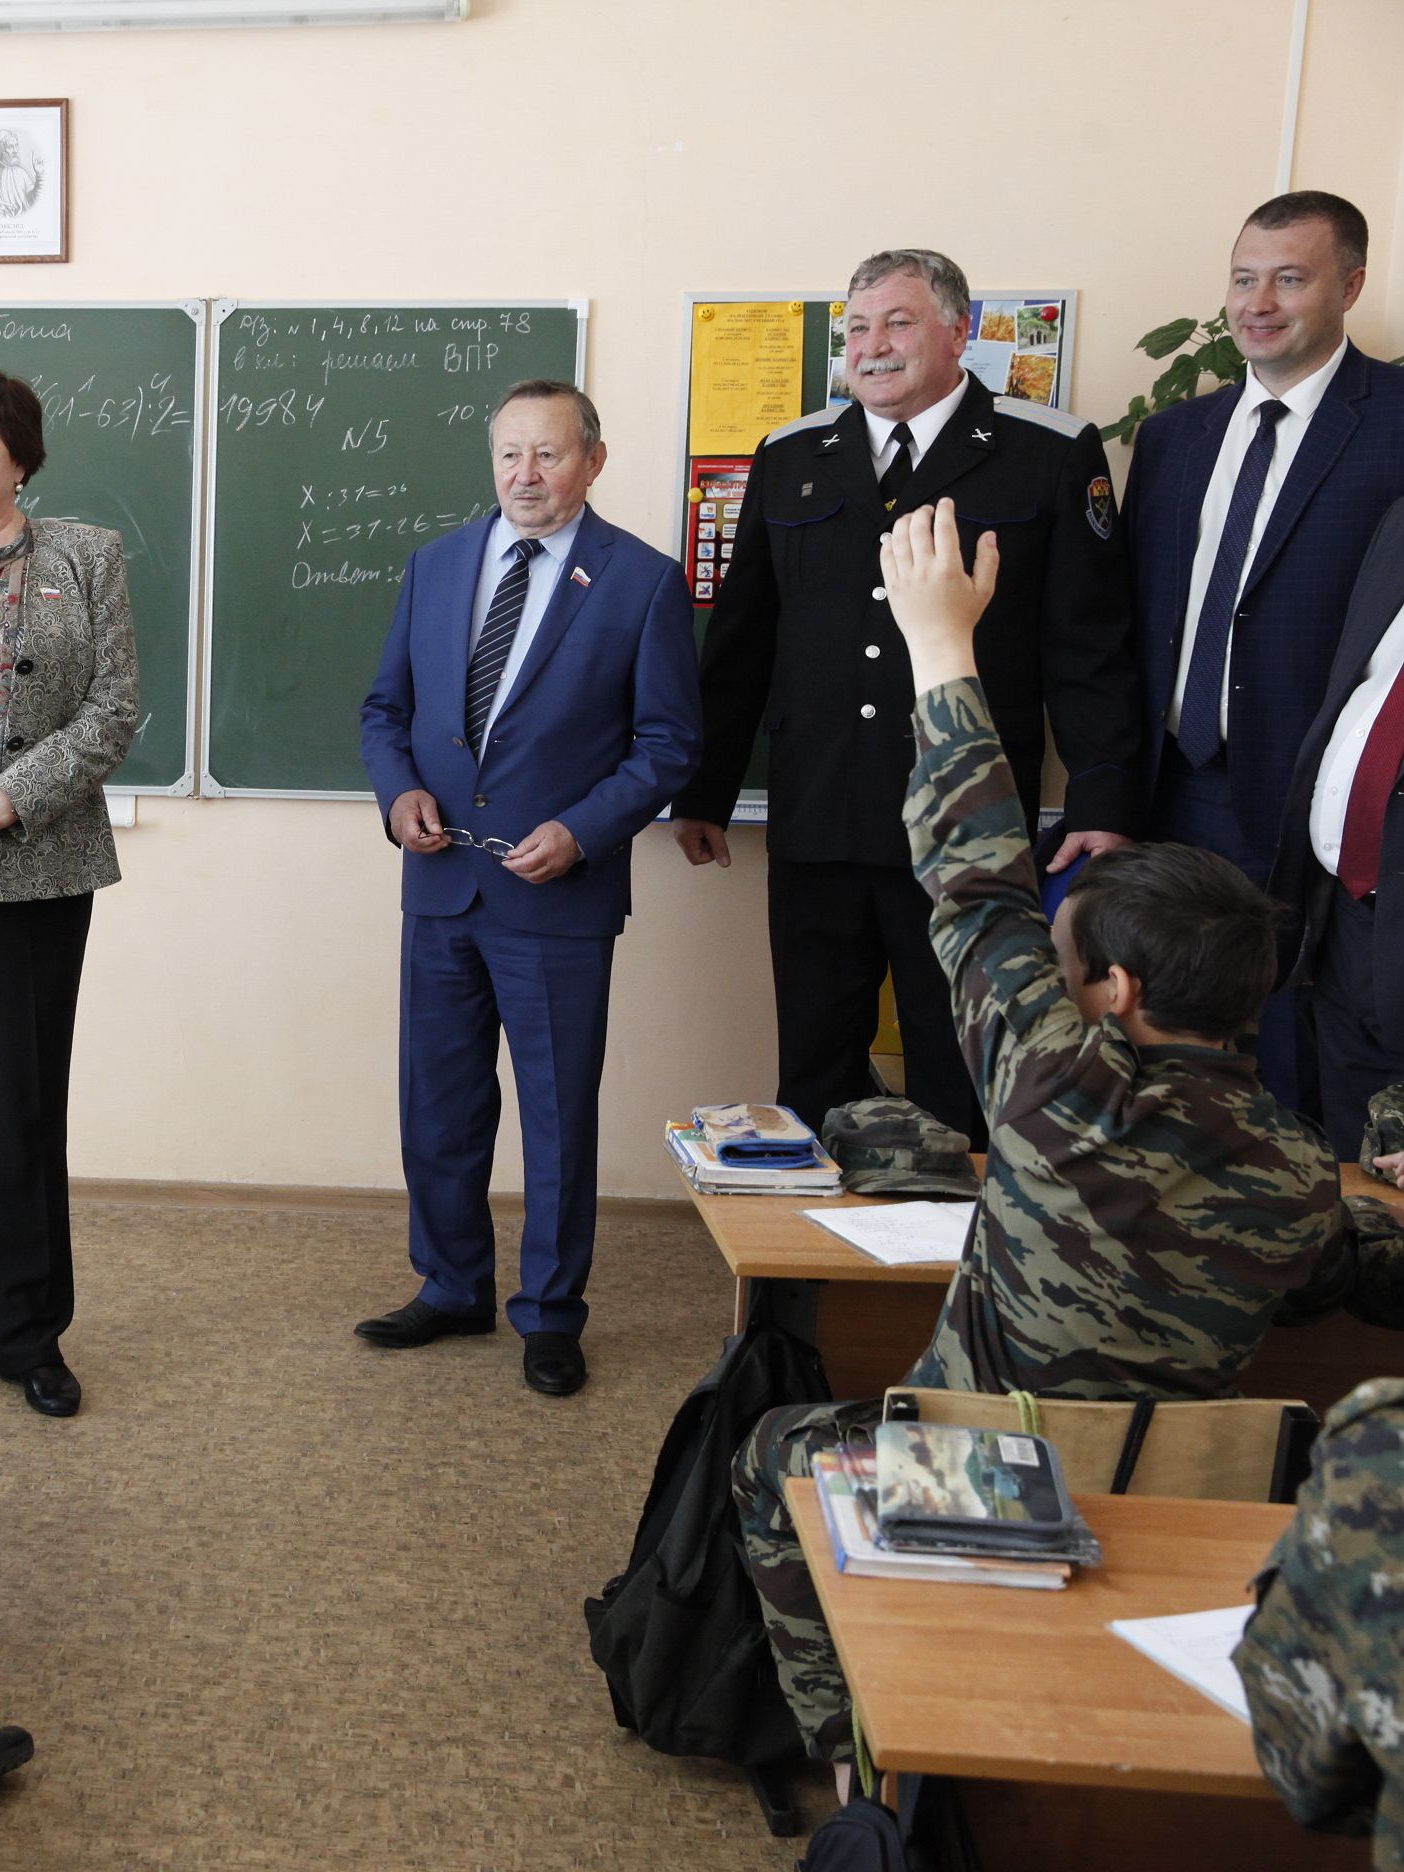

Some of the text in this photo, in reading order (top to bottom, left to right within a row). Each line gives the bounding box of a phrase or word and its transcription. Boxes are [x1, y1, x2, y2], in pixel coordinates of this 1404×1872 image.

[415, 317, 441, 333] на
[500, 312, 531, 334] 78
[444, 342, 499, 373] ВПР
